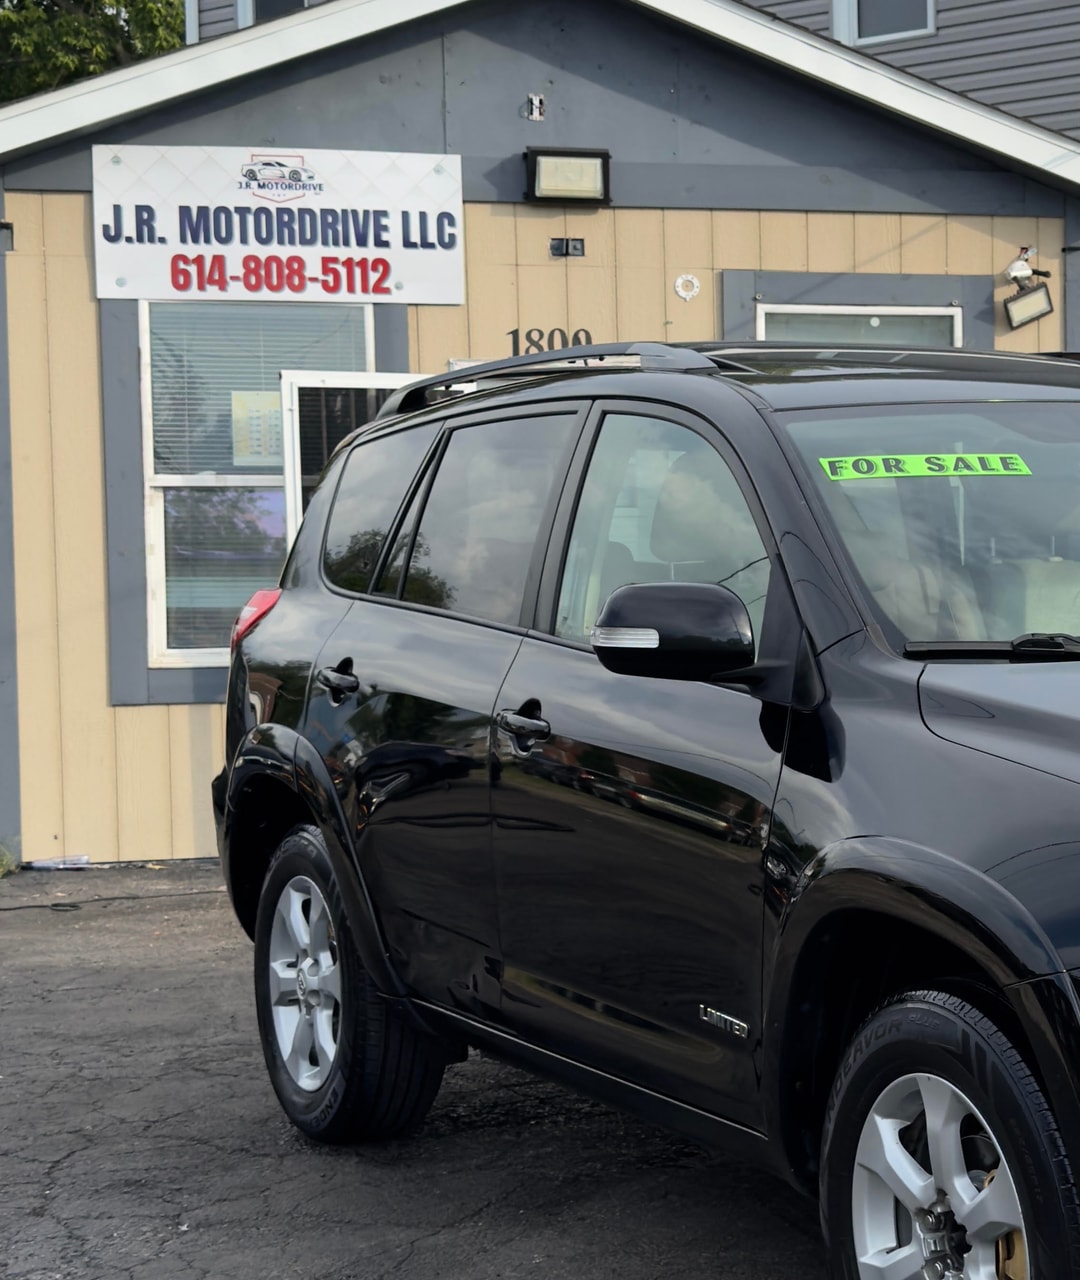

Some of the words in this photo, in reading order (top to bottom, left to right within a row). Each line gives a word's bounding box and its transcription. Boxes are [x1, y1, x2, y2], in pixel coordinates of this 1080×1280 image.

[257, 181, 324, 192] MOTORDRIVE
[102, 204, 167, 244] J.R.
[178, 205, 392, 249] MOTORDRIVE
[401, 210, 458, 250] LLC
[170, 253, 392, 295] 614-808-5112
[828, 457, 907, 478] FOR
[924, 455, 1022, 473] SALE
